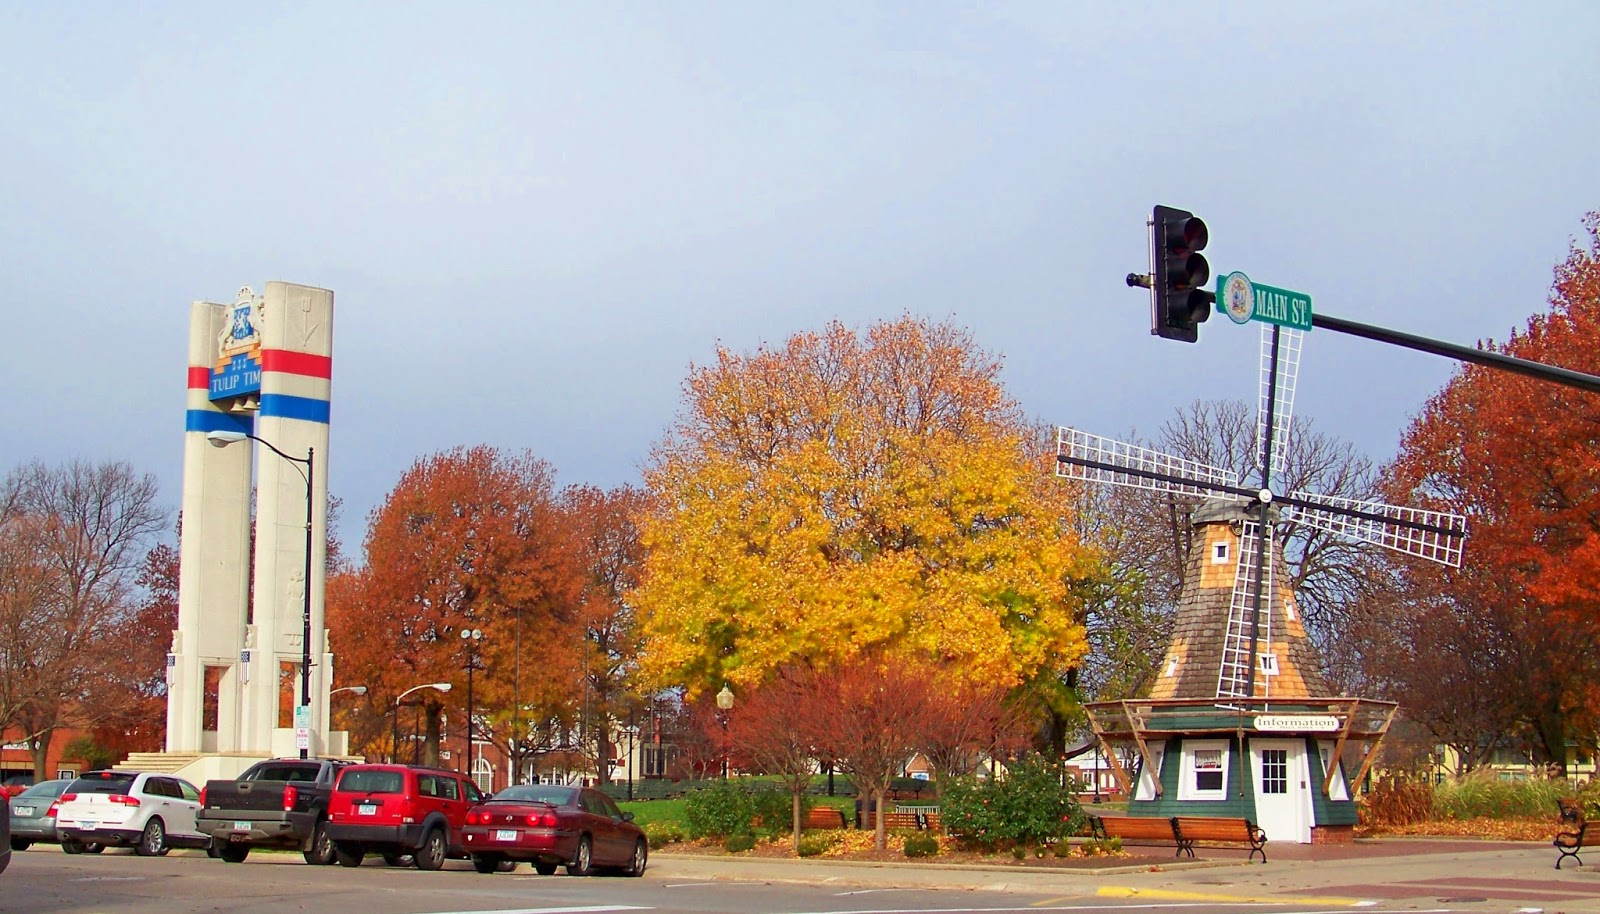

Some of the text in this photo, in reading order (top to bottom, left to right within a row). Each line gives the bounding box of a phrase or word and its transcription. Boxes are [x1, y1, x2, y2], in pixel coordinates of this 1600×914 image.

[1256, 289, 1288, 321] MAIN
[1292, 298, 1309, 326] ST.
[212, 370, 261, 393] TULIP TIM
[1258, 718, 1335, 726] Information
